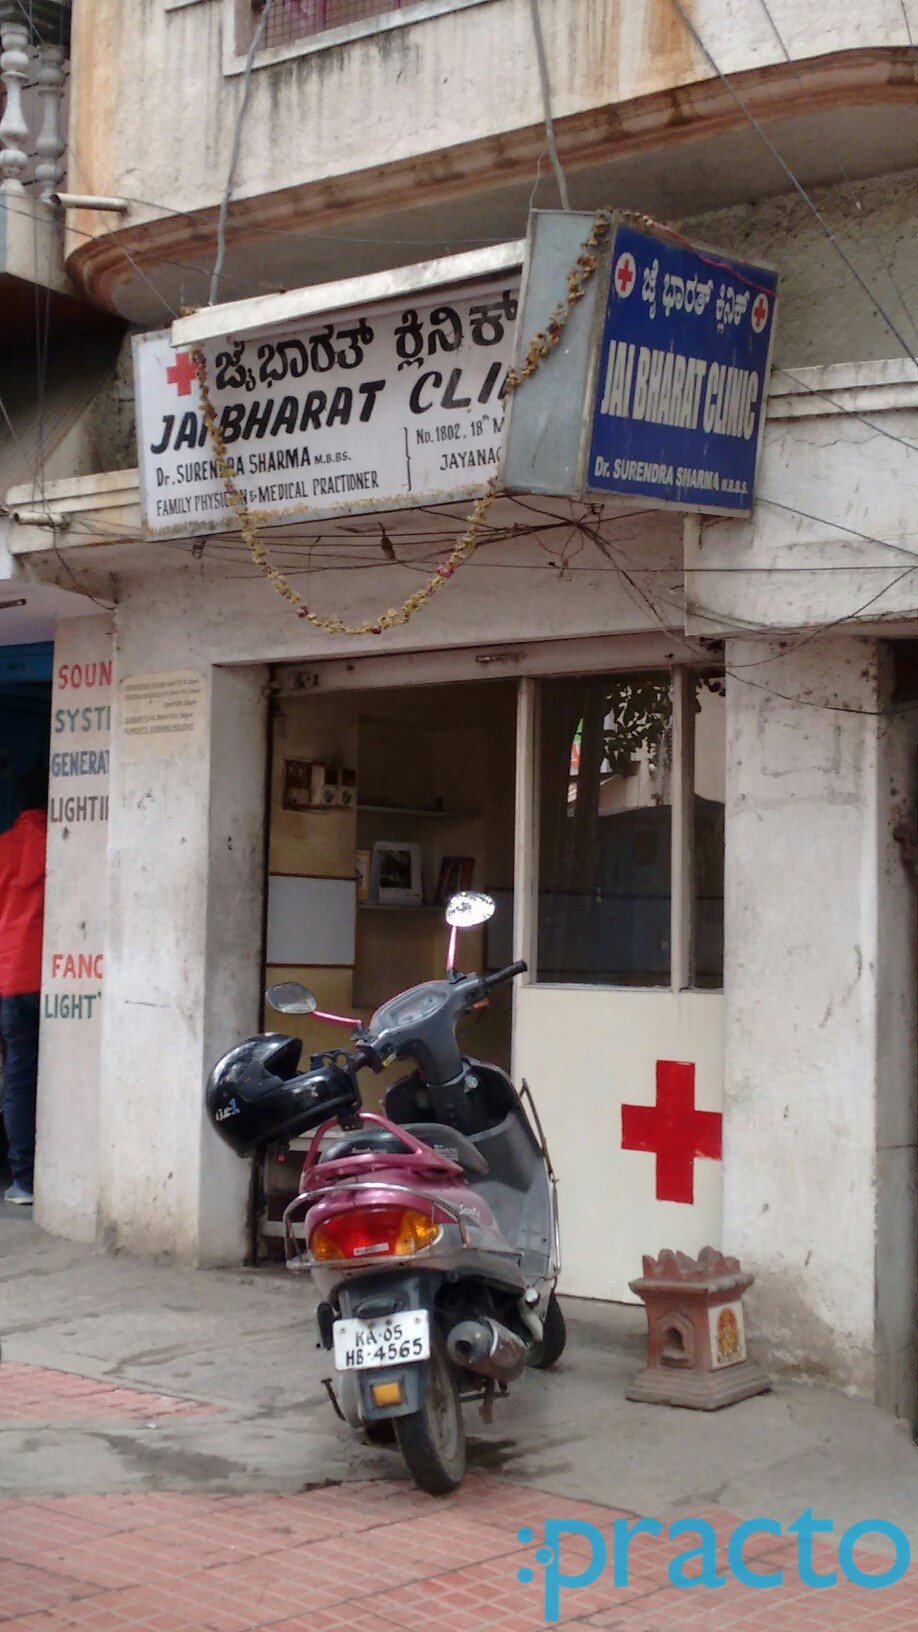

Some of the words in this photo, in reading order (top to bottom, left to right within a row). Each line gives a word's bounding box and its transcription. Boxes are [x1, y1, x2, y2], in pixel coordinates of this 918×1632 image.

[600, 339, 636, 418] JAI
[632, 346, 707, 430] BHARAT
[703, 361, 759, 440] CLINIC
[150, 410, 210, 454] JAI
[220, 379, 386, 444] BHARAT
[176, 456, 245, 484] SURENRA
[249, 446, 311, 474] SHARMA
[594, 455, 610, 478] Dr.
[613, 458, 673, 486] SURENDRA
[675, 466, 720, 492] SHARMA
[156, 496, 192, 517] FAMILY
[194, 489, 248, 512] PHYSICN
[249, 489, 258, 503] &
[258, 480, 309, 503] MEDICAL
[312, 470, 379, 496] PRACTIONER
[58, 660, 112, 690] SOUN
[52, 953, 104, 979] FANC
[44, 991, 102, 1020] LIGHT
